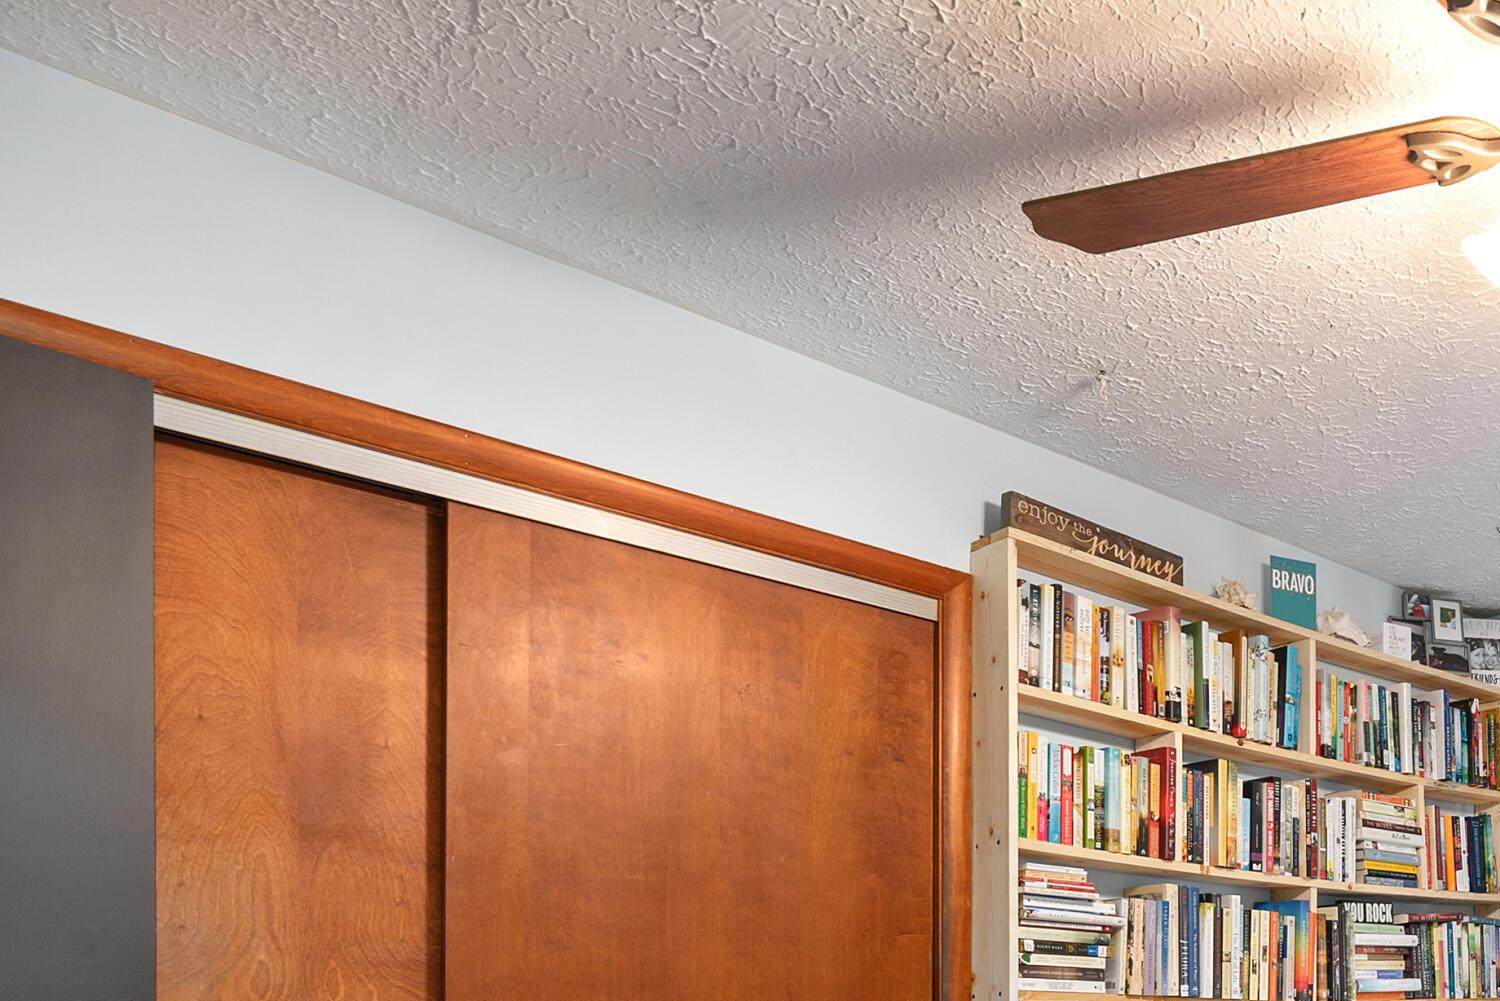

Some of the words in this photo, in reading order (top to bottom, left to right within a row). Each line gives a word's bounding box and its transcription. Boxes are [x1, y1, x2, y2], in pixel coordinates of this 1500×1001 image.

[1018, 500, 1070, 531] enjoy
[1073, 522, 1092, 536] the
[1072, 528, 1184, 582] journey
[1272, 569, 1314, 595] BRAVO
[1344, 902, 1364, 923] YOU
[1365, 903, 1392, 923] ROCK
